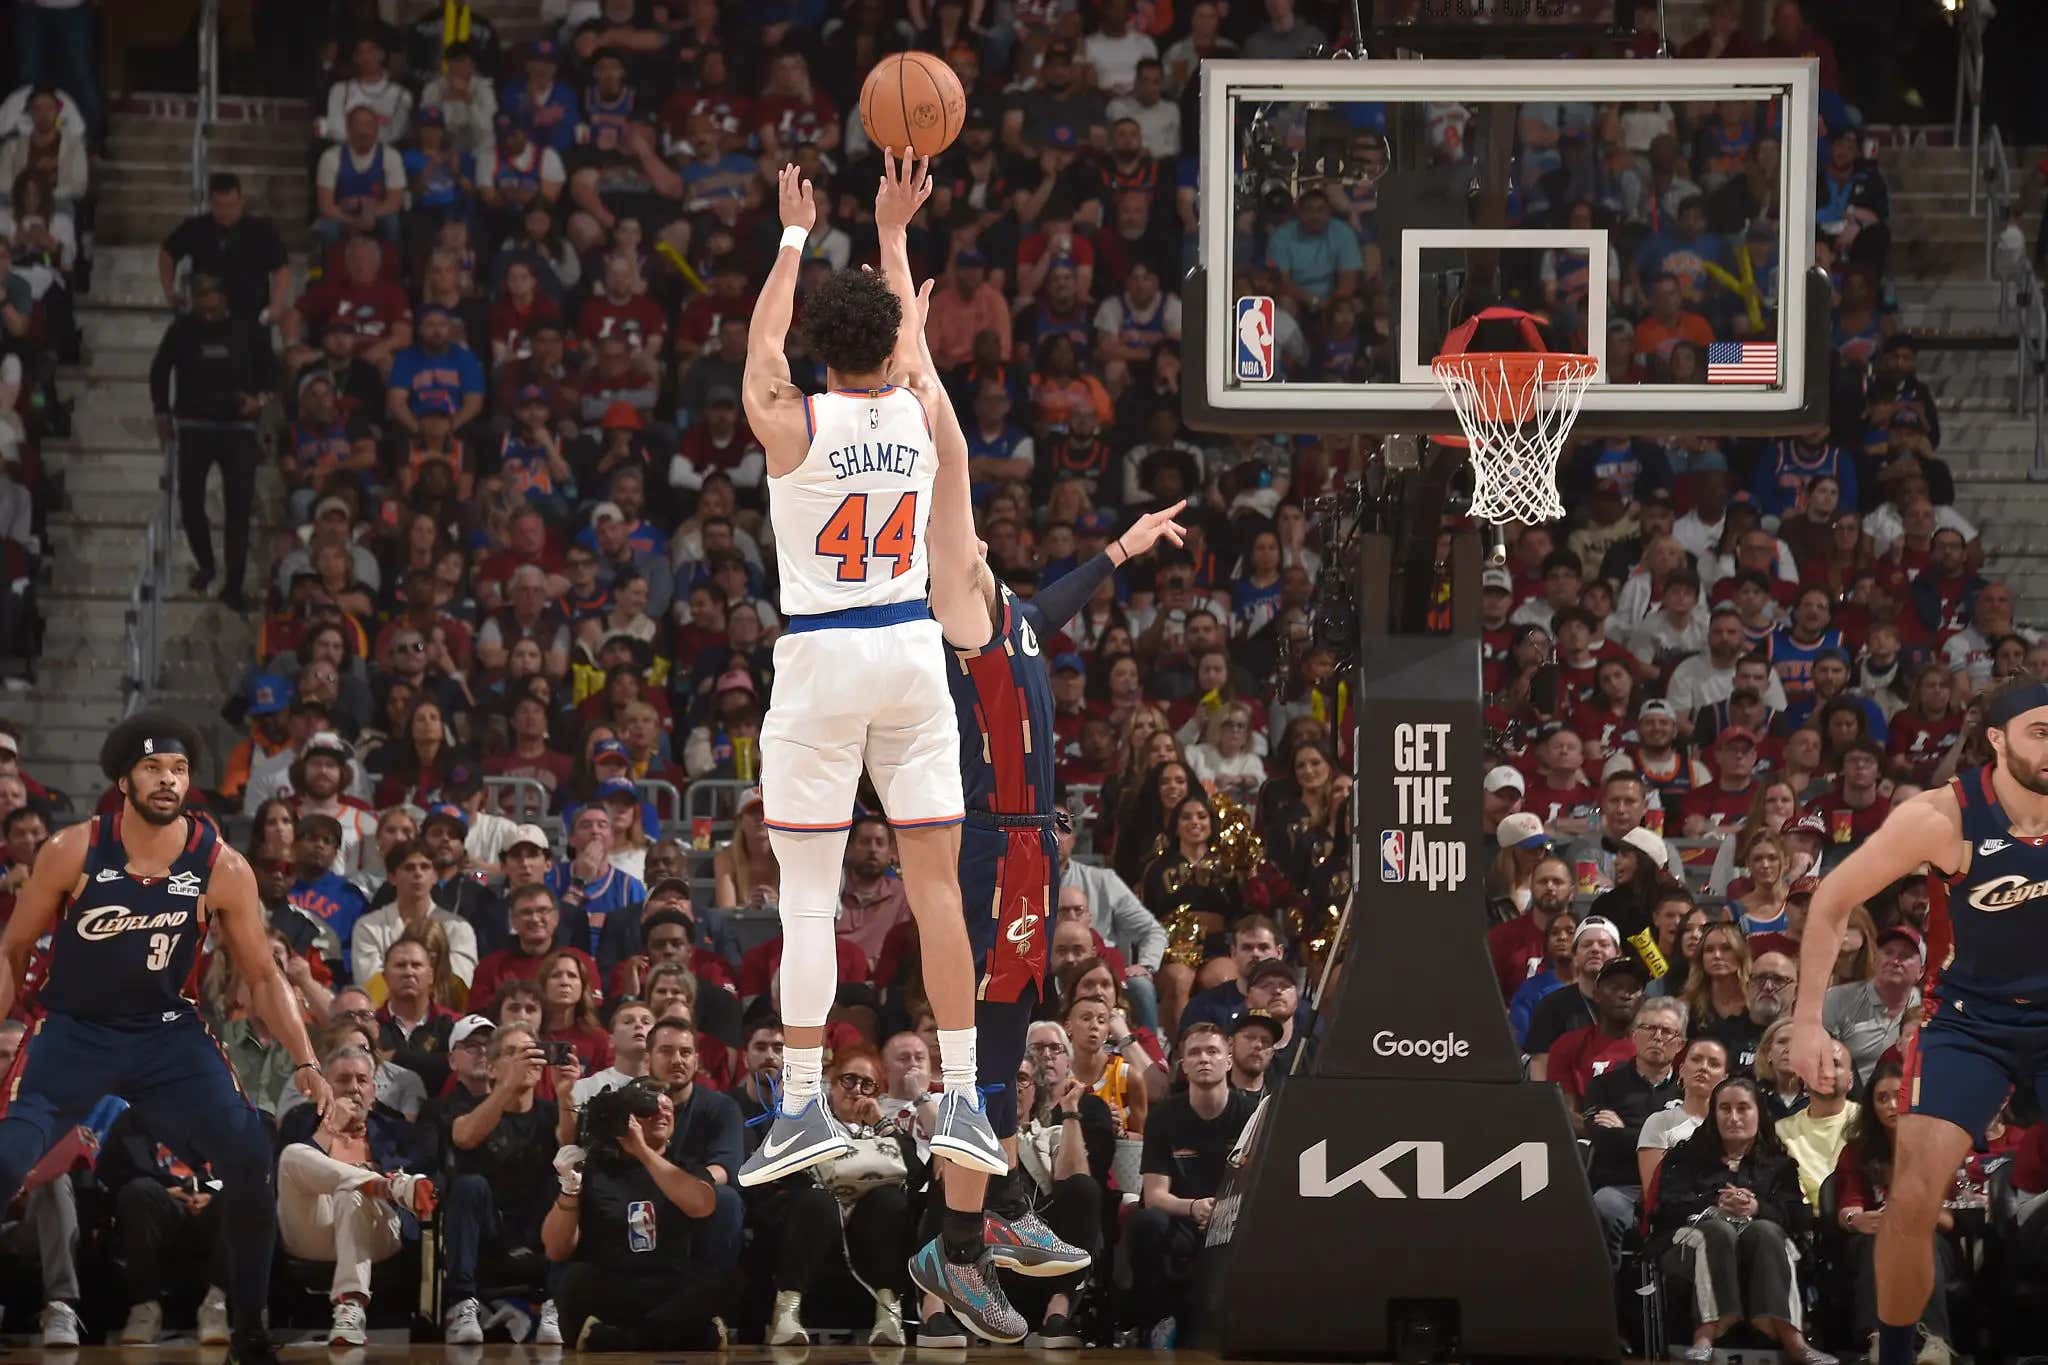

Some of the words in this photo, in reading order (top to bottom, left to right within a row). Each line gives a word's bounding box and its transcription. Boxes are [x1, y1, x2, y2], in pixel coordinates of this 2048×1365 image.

[1242, 361, 1260, 376] NBA
[828, 442, 919, 481] SHAMET
[816, 491, 918, 583] 44
[1394, 723, 1452, 773] GET
[1394, 777, 1452, 825] THE
[1408, 831, 1467, 892] App
[169, 886, 199, 895] CLIFFS
[76, 905, 188, 941] CLEVELAND
[146, 932, 182, 972] 31
[1372, 1030, 1470, 1063] Google
[1299, 1138, 1549, 1202] KIA
